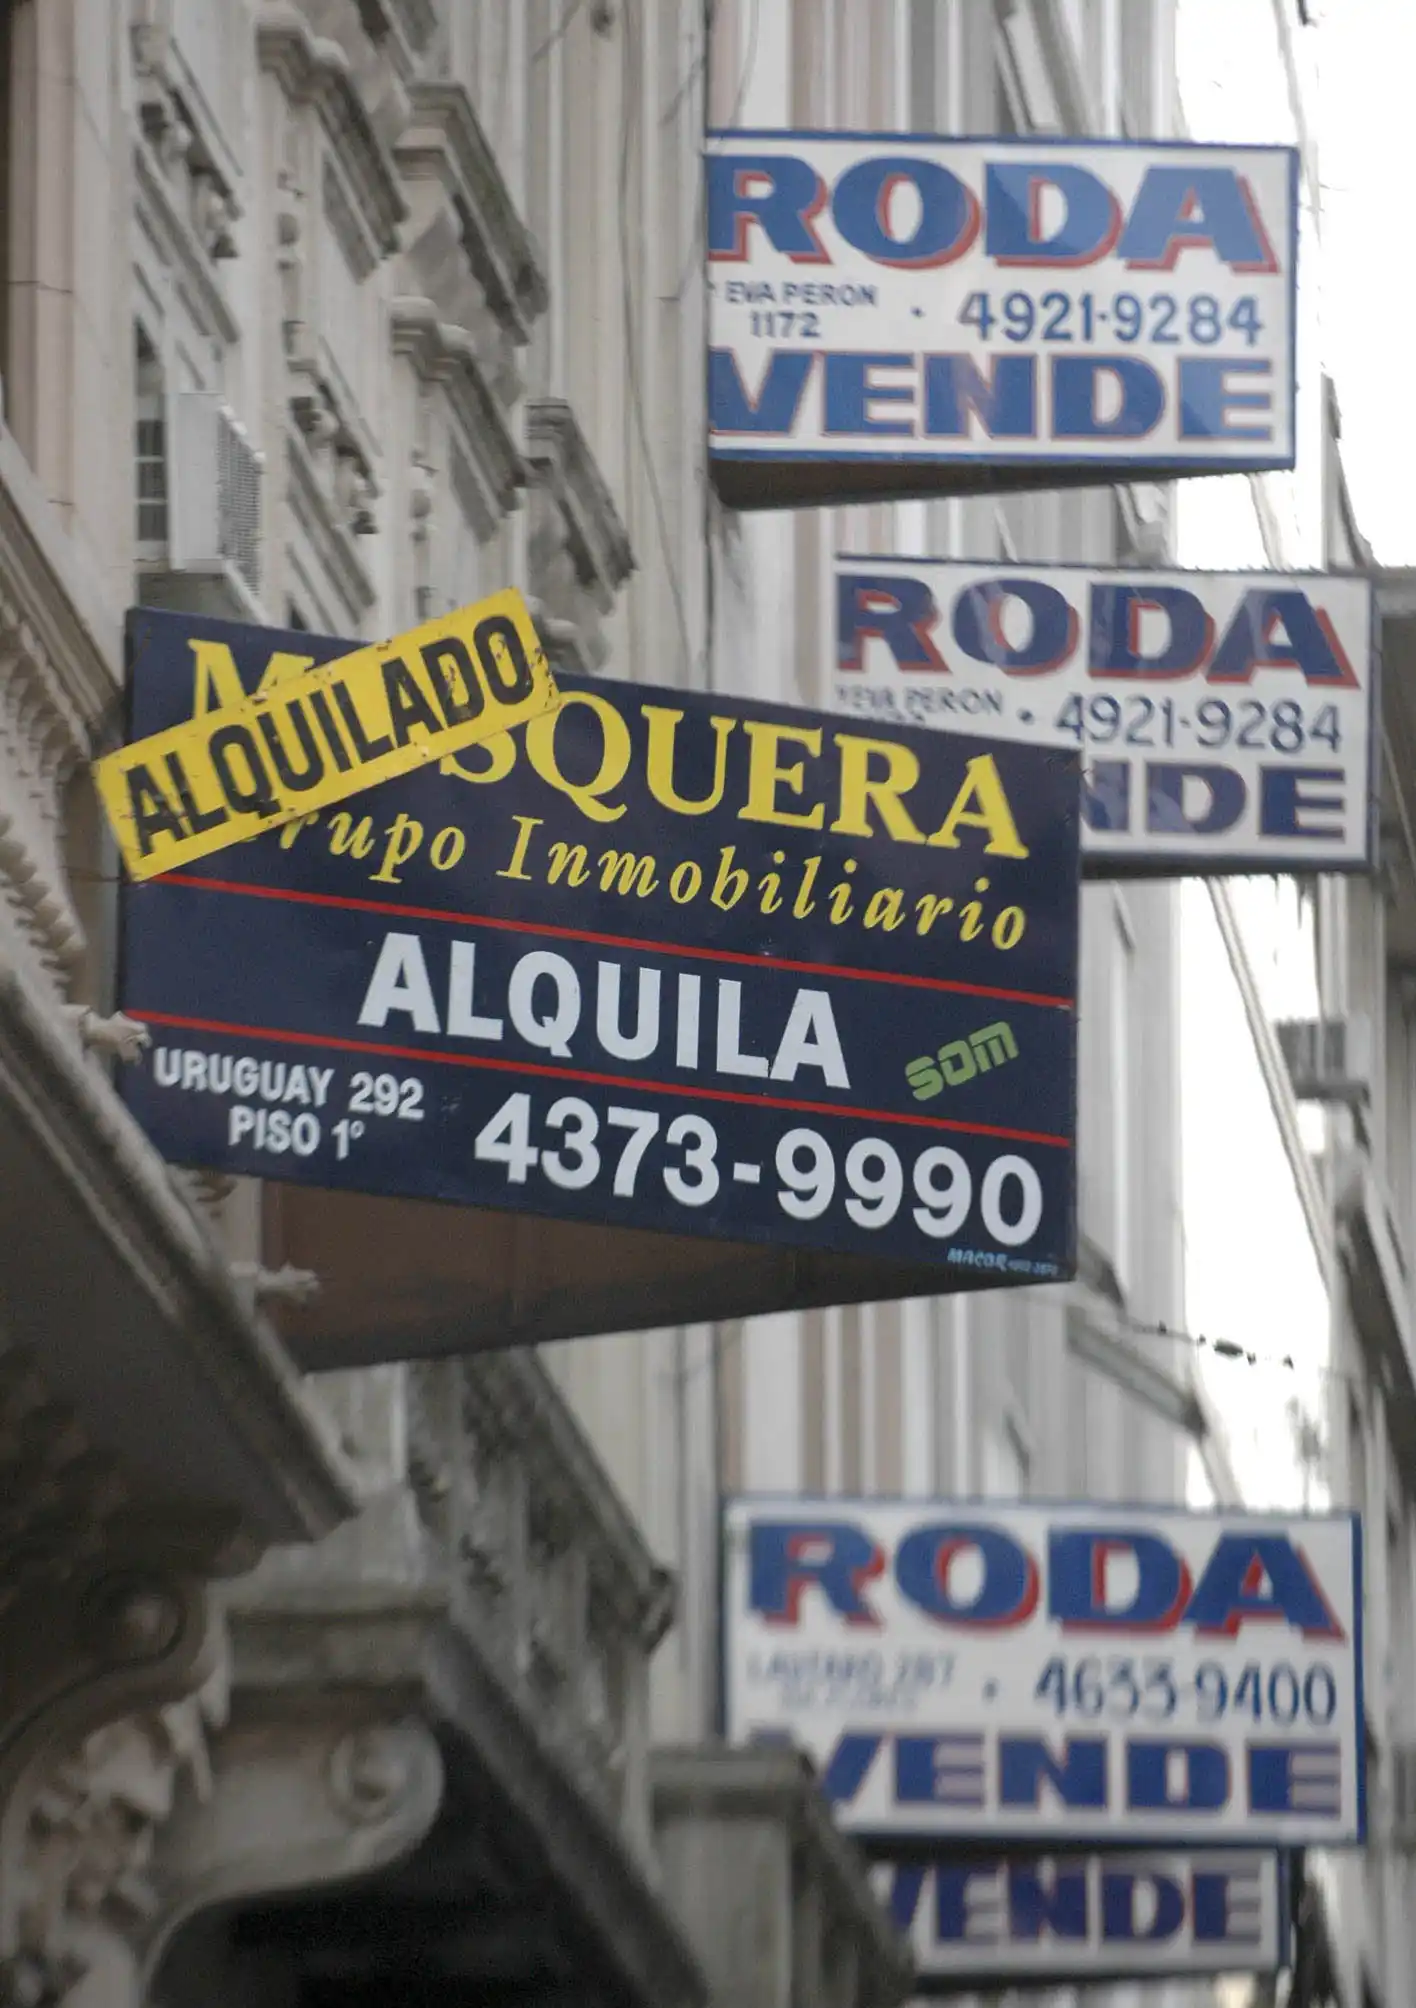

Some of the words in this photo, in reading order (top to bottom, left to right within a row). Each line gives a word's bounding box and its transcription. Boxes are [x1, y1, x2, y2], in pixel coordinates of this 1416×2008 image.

[708, 154, 1280, 274] RODA
[726, 279, 776, 303] EVA
[782, 280, 879, 308] PERON
[749, 310, 821, 338] 1172
[709, 346, 1273, 441] VENDE
[835, 574, 1361, 690] RODA
[125, 614, 534, 858] ALQUILADO
[279, 810, 466, 885] rupo
[497, 815, 1027, 950] Inmobiliario
[357, 931, 852, 1089] ALQUILA
[152, 1046, 335, 1108] URUGUAY
[347, 1071, 426, 1121] 292
[227, 1104, 321, 1157] PISO
[474, 1091, 1044, 1248] 4373-9990
[747, 1520, 1347, 1645] RODA
